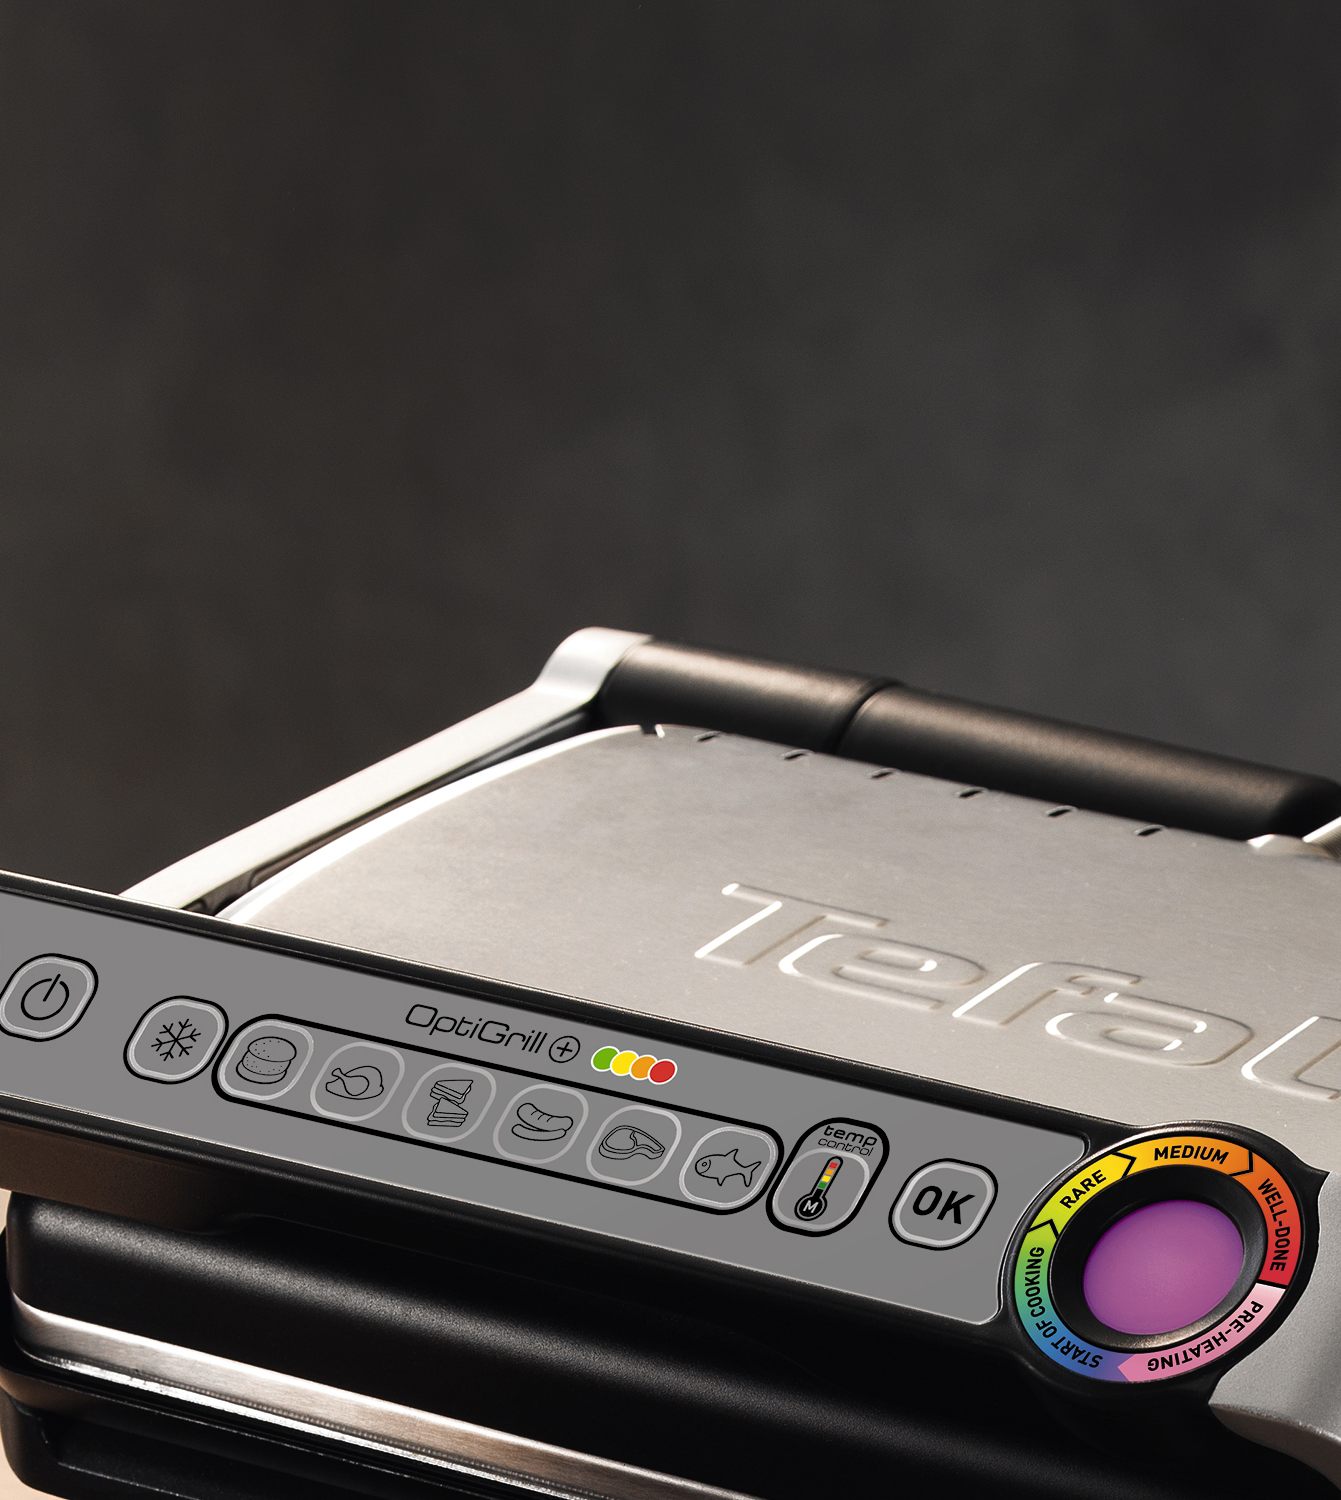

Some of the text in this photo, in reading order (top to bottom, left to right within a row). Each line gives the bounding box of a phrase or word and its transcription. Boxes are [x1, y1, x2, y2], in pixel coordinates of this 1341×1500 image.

[405, 1003, 548, 1054] OptiGrill
[818, 1138, 874, 1157] control
[823, 1125, 878, 1147] temp
[1154, 1145, 1229, 1165] MEDIUM
[803, 1200, 820, 1214] M
[913, 1185, 975, 1225] OK
[1060, 1169, 1107, 1209] RARE
[1257, 1178, 1291, 1272] WELL-DONE
[1025, 1246, 1104, 1369] START OF COOKING
[1147, 1300, 1264, 1372] PRE-HEATING
